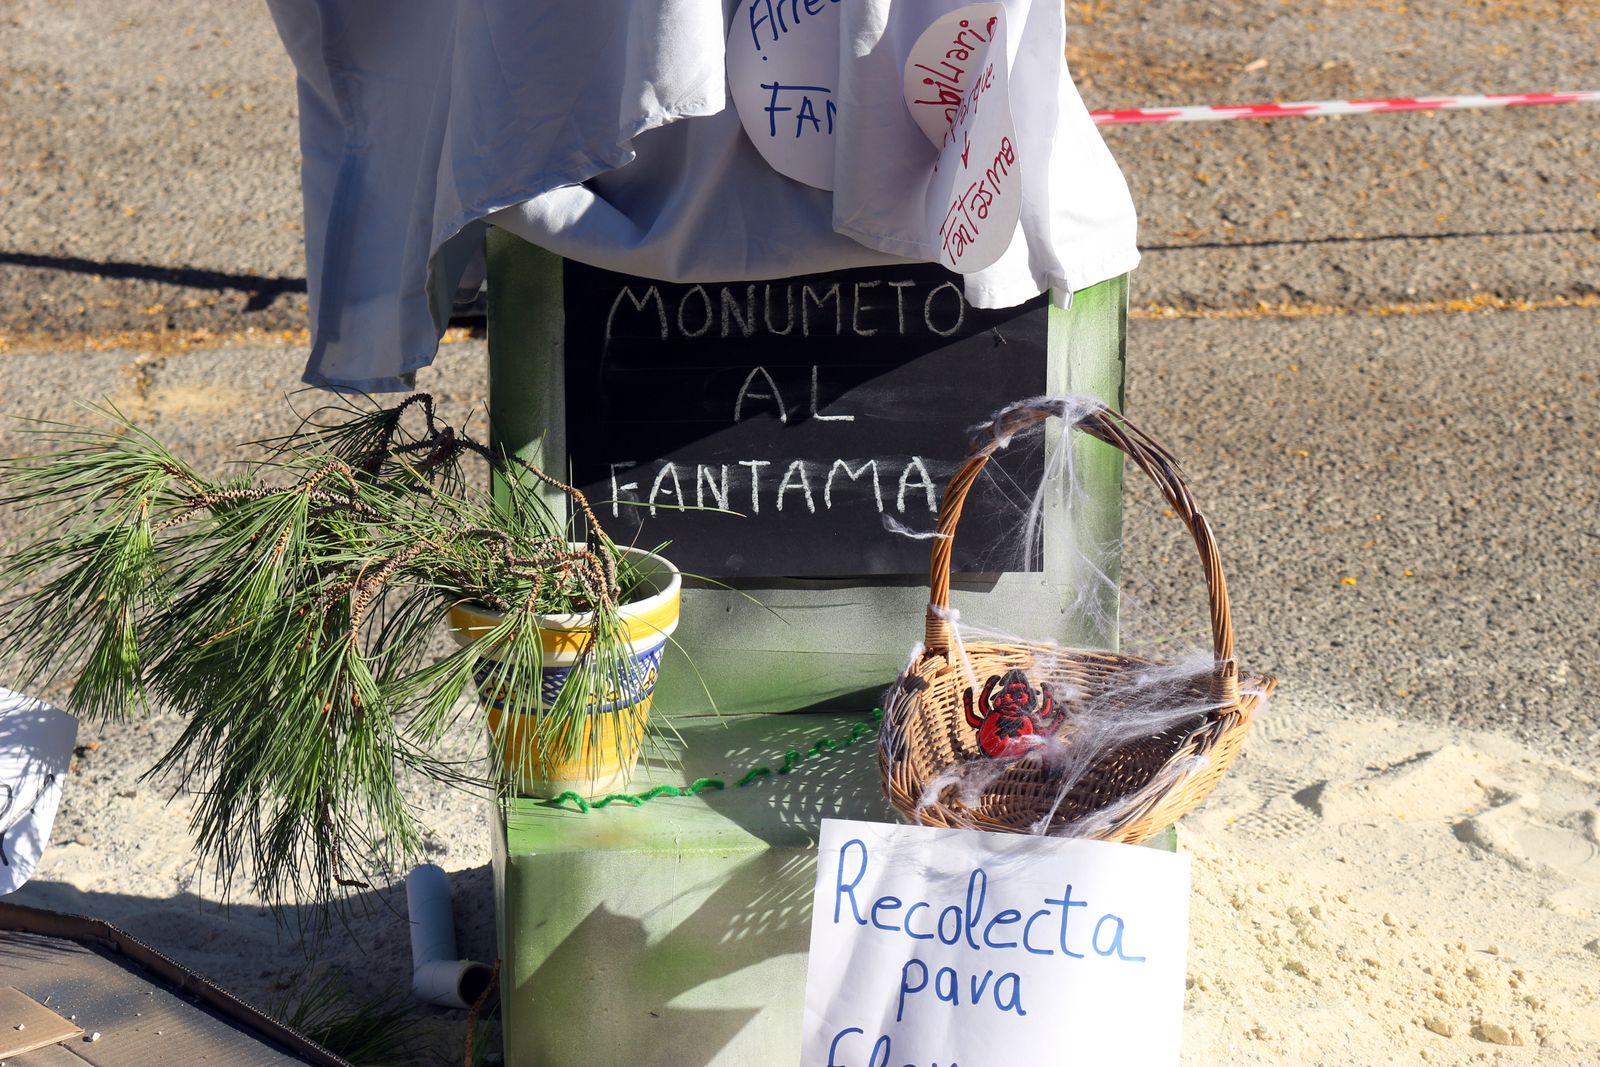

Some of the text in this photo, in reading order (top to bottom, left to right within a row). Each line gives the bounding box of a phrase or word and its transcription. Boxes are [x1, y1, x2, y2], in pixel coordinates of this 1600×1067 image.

[606, 280, 965, 341] MONUMETO
[734, 364, 856, 424] AL
[610, 456, 939, 518] FANTAMA
[834, 838, 1147, 962] Recolecta
